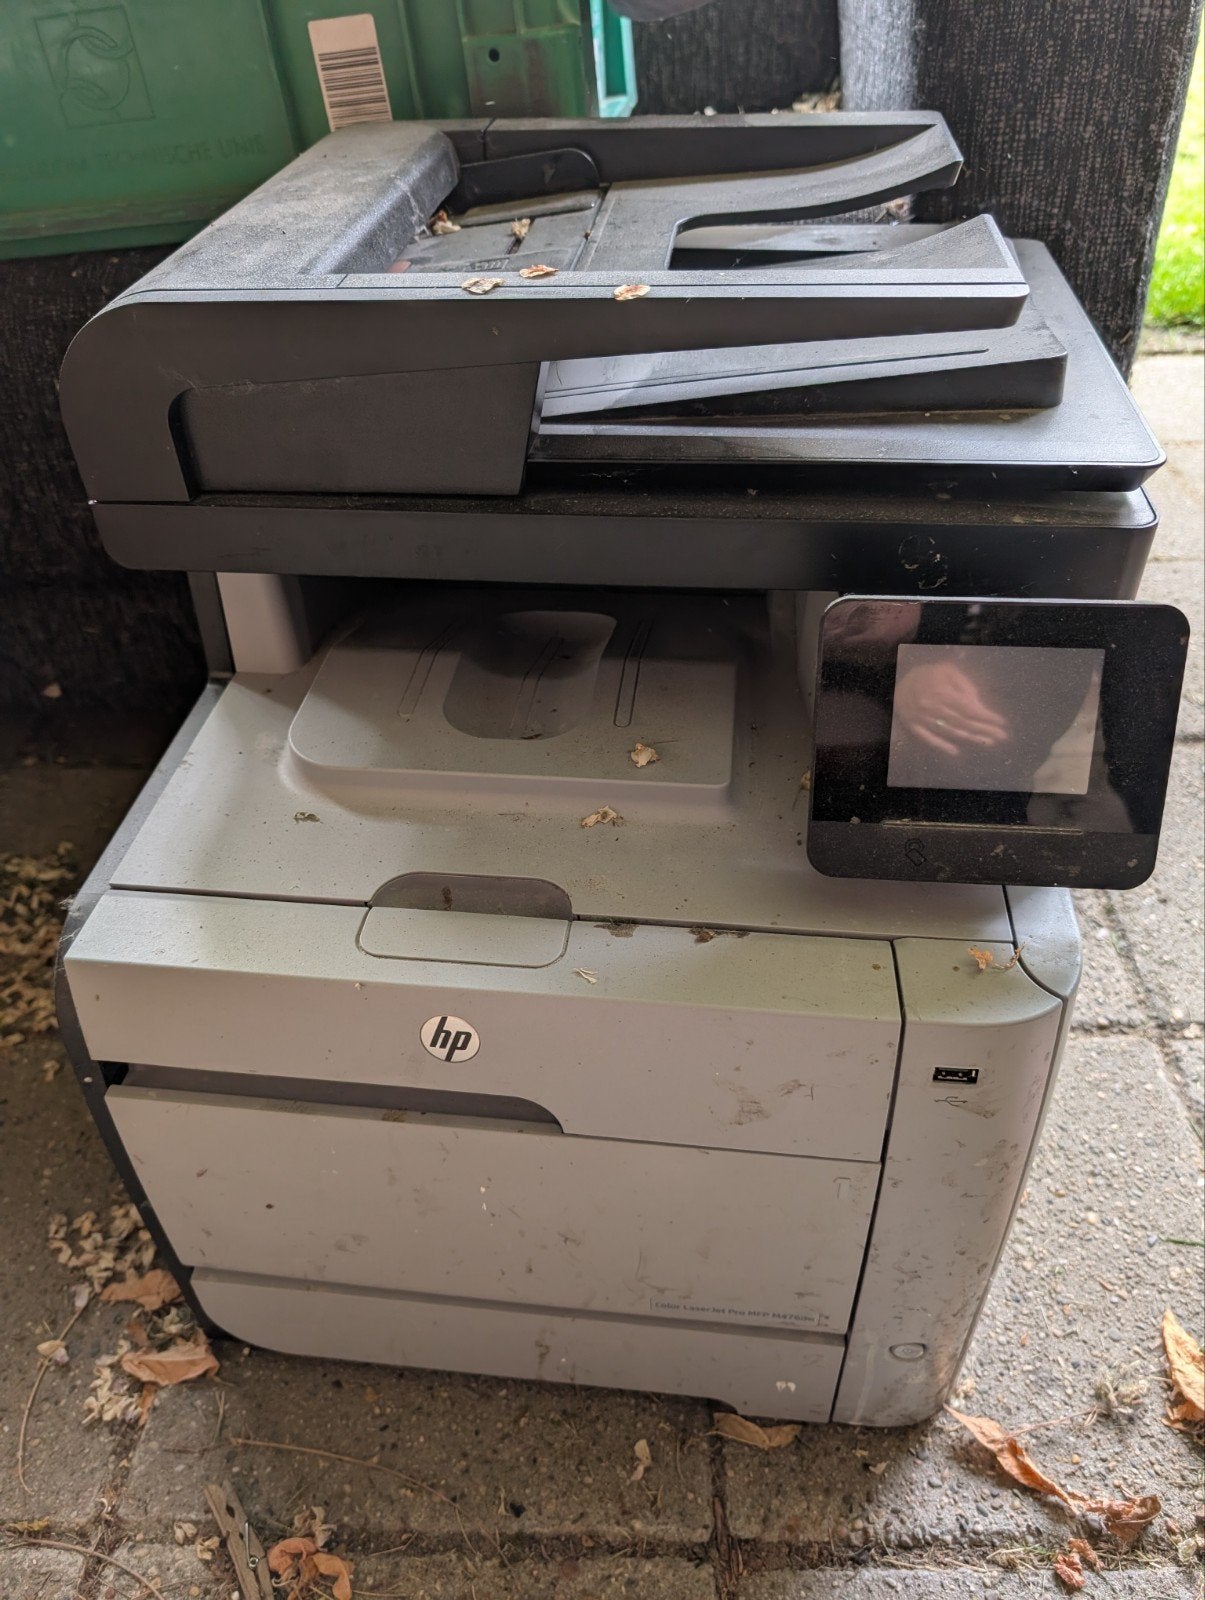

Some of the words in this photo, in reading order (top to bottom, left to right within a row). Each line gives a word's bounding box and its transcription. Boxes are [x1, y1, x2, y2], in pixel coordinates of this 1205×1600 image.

[429, 1015, 473, 1062] hp
[654, 1301, 680, 1310] Color
[682, 1304, 725, 1314] LaserJet
[727, 1308, 746, 1316] Pro
[747, 1310, 771, 1318] MFP
